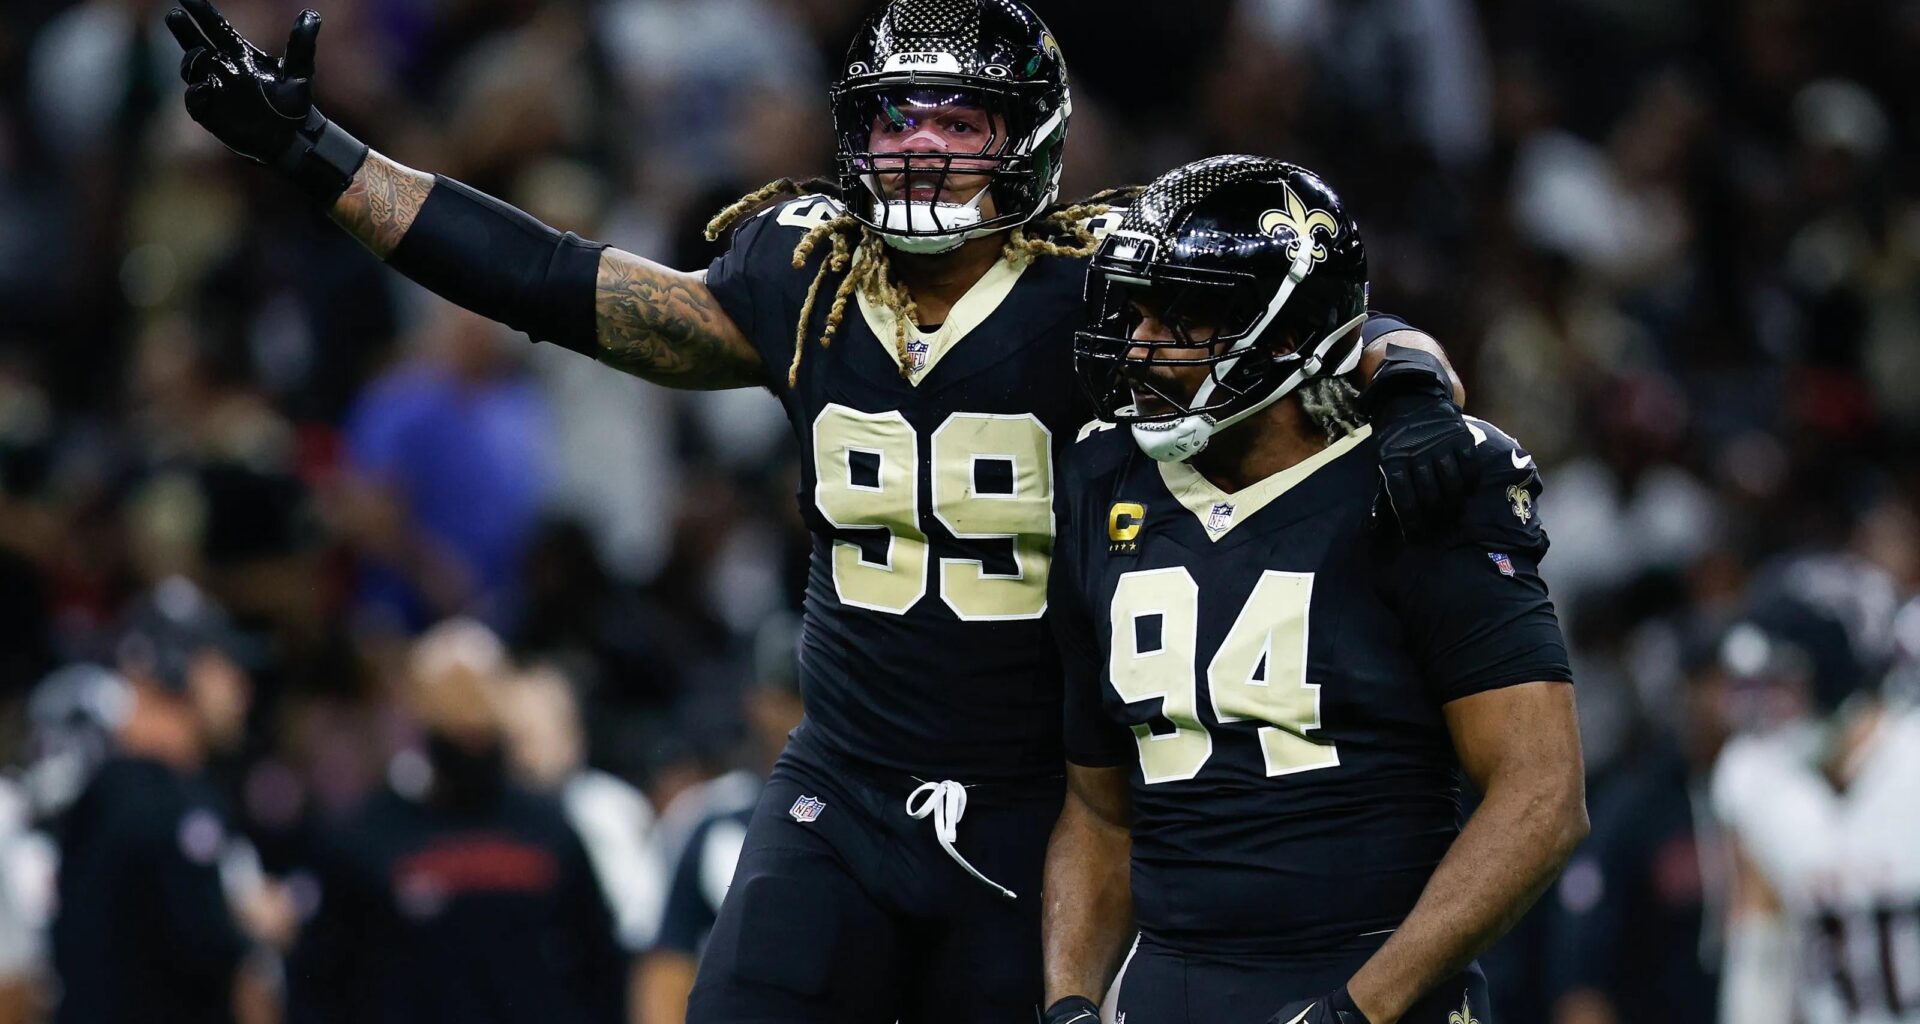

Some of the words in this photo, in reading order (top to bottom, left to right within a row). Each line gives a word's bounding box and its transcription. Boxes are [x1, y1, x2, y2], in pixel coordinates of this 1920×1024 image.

[899, 54, 938, 65] SAINTS
[813, 402, 1056, 621] 99
[1108, 502, 1145, 541] C
[1109, 566, 1340, 785] 94
